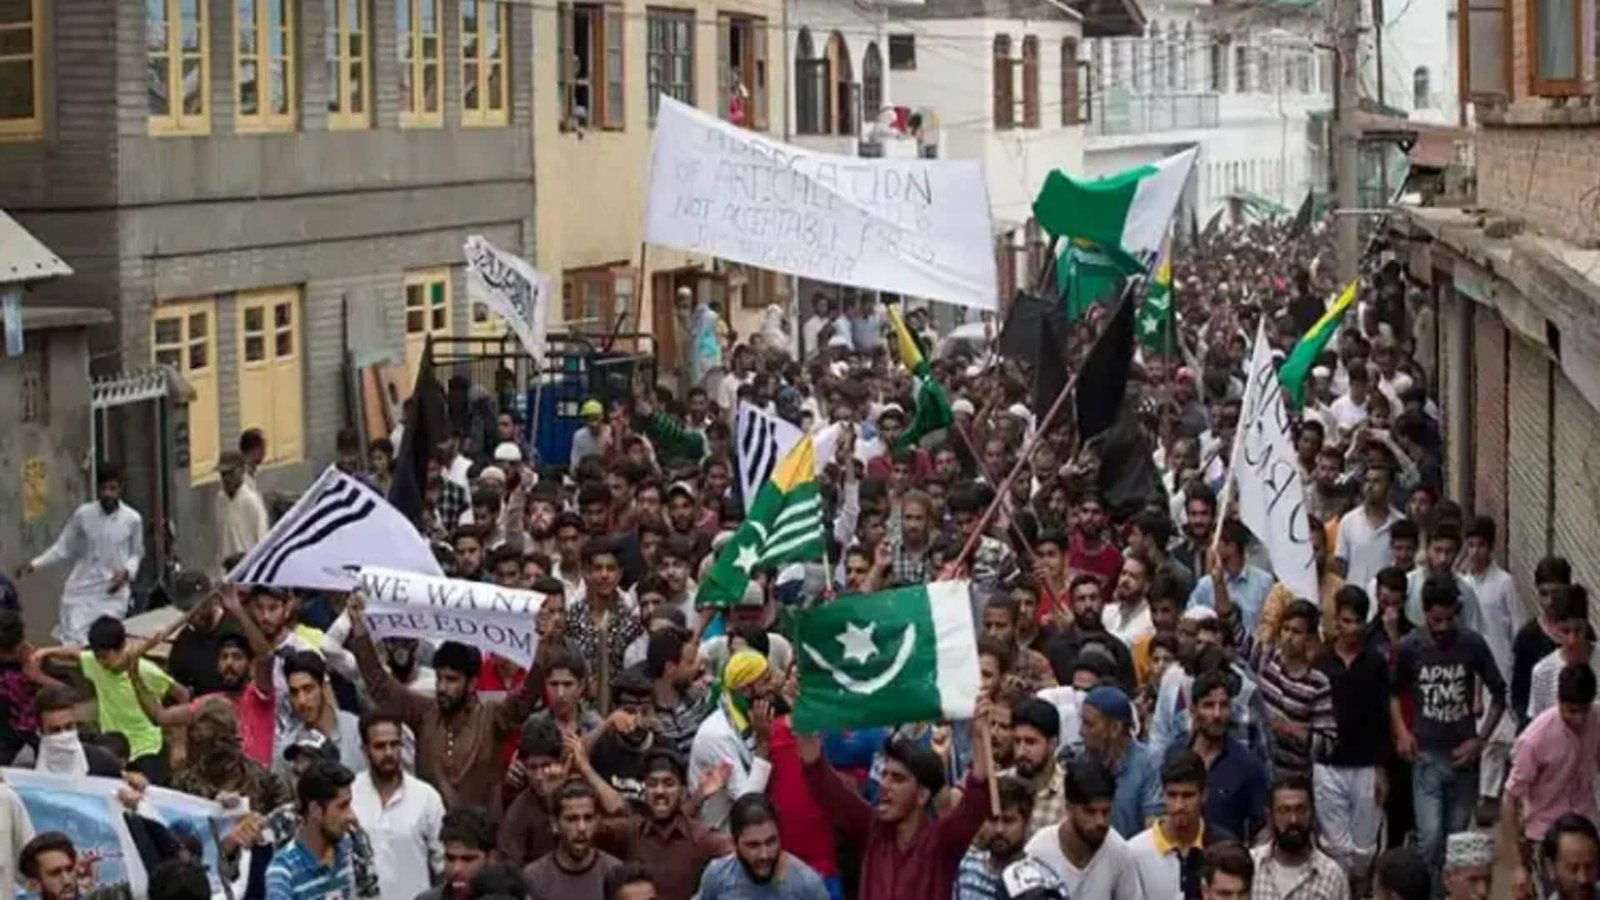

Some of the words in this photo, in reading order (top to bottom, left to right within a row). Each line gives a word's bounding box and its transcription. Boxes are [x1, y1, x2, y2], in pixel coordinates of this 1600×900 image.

[361, 574, 411, 602] WE
[367, 613, 532, 656] FREEDOM
[1419, 663, 1466, 681] APNA
[1419, 681, 1466, 704] TIME
